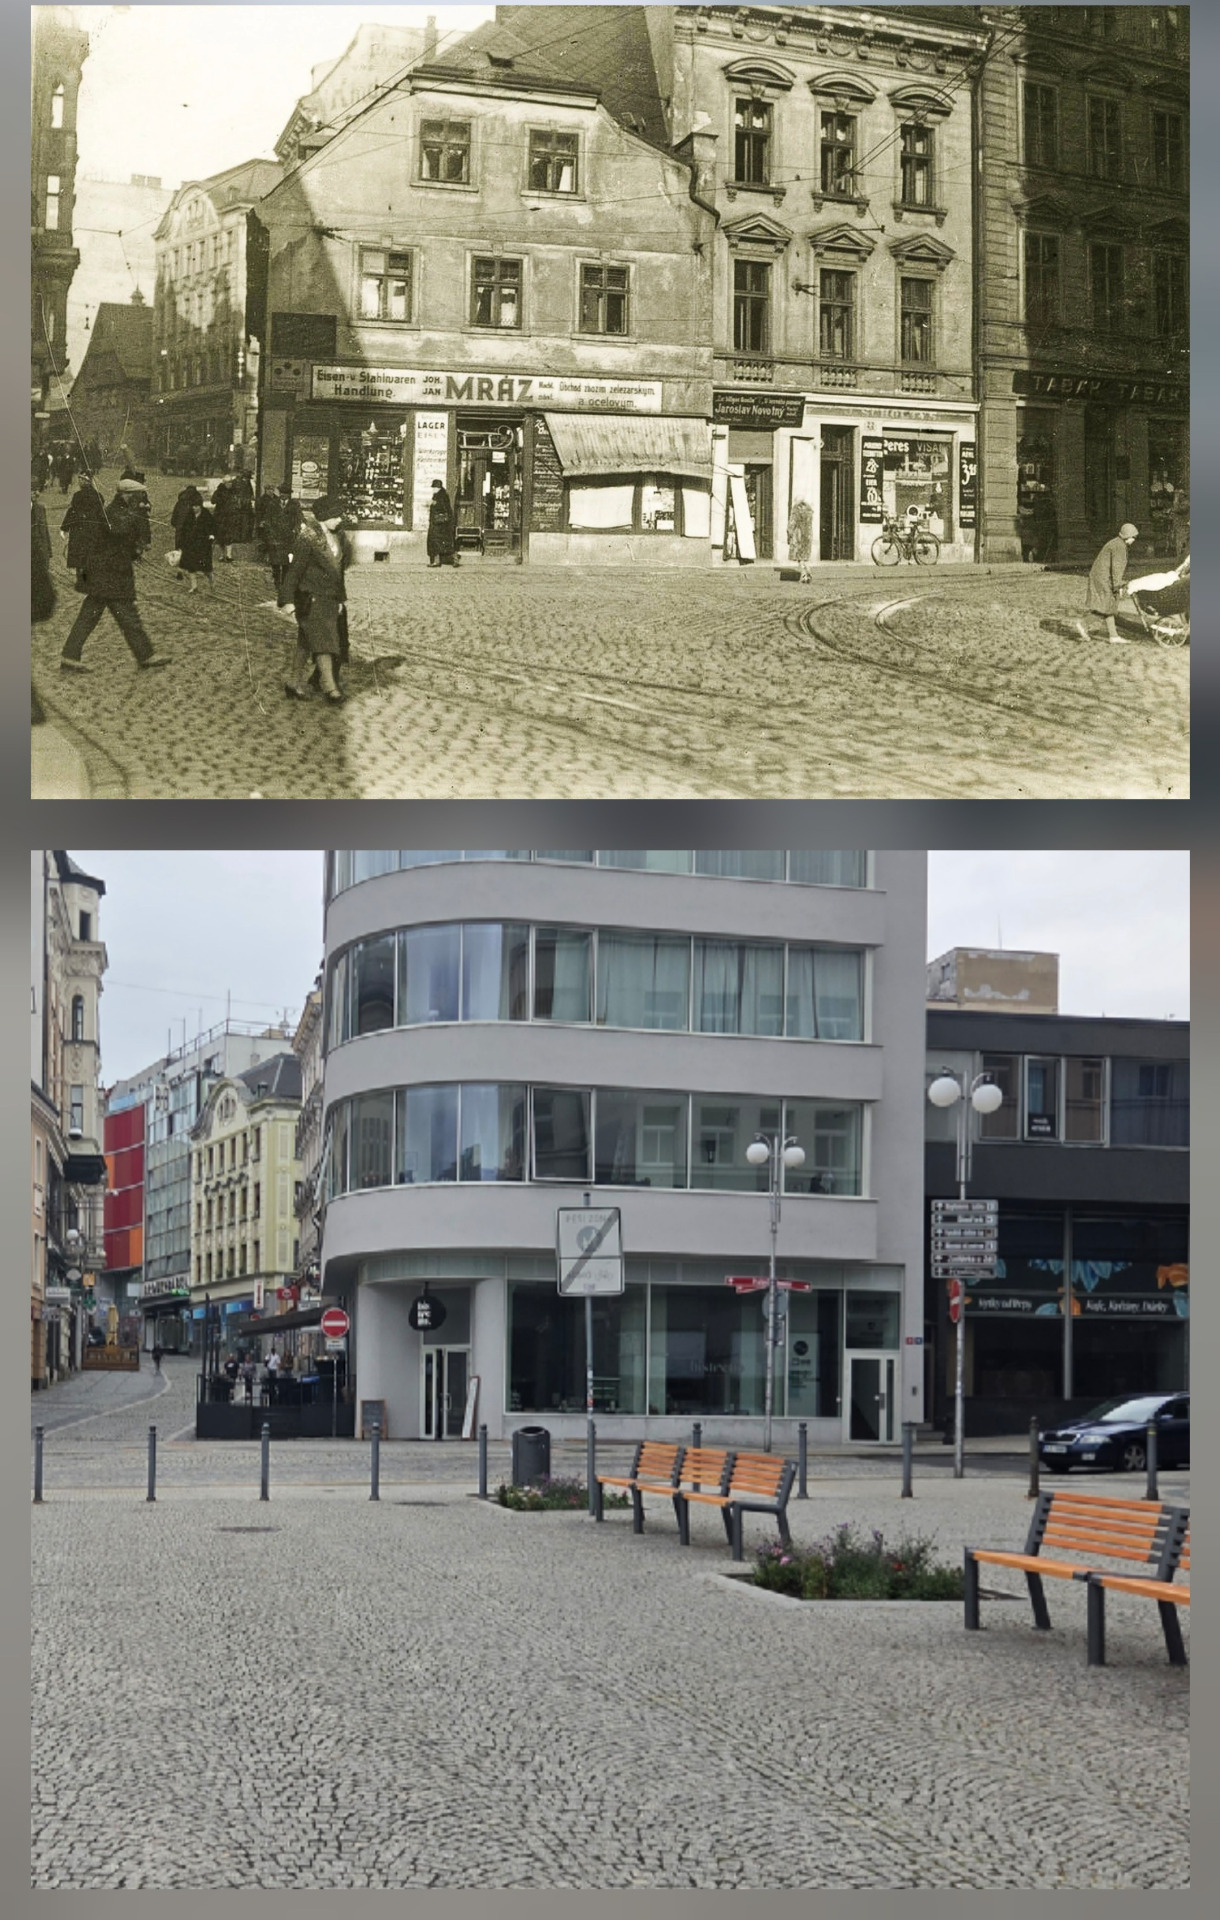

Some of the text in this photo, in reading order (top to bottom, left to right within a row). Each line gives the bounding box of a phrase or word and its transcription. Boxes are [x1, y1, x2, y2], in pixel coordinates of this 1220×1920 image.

[359, 371, 416, 384] Stahlwaren
[422, 388, 441, 396] JAN
[444, 375, 534, 402] MRÁZ
[714, 403, 752, 415] Jaroslav
[417, 421, 445, 430] LAGER
